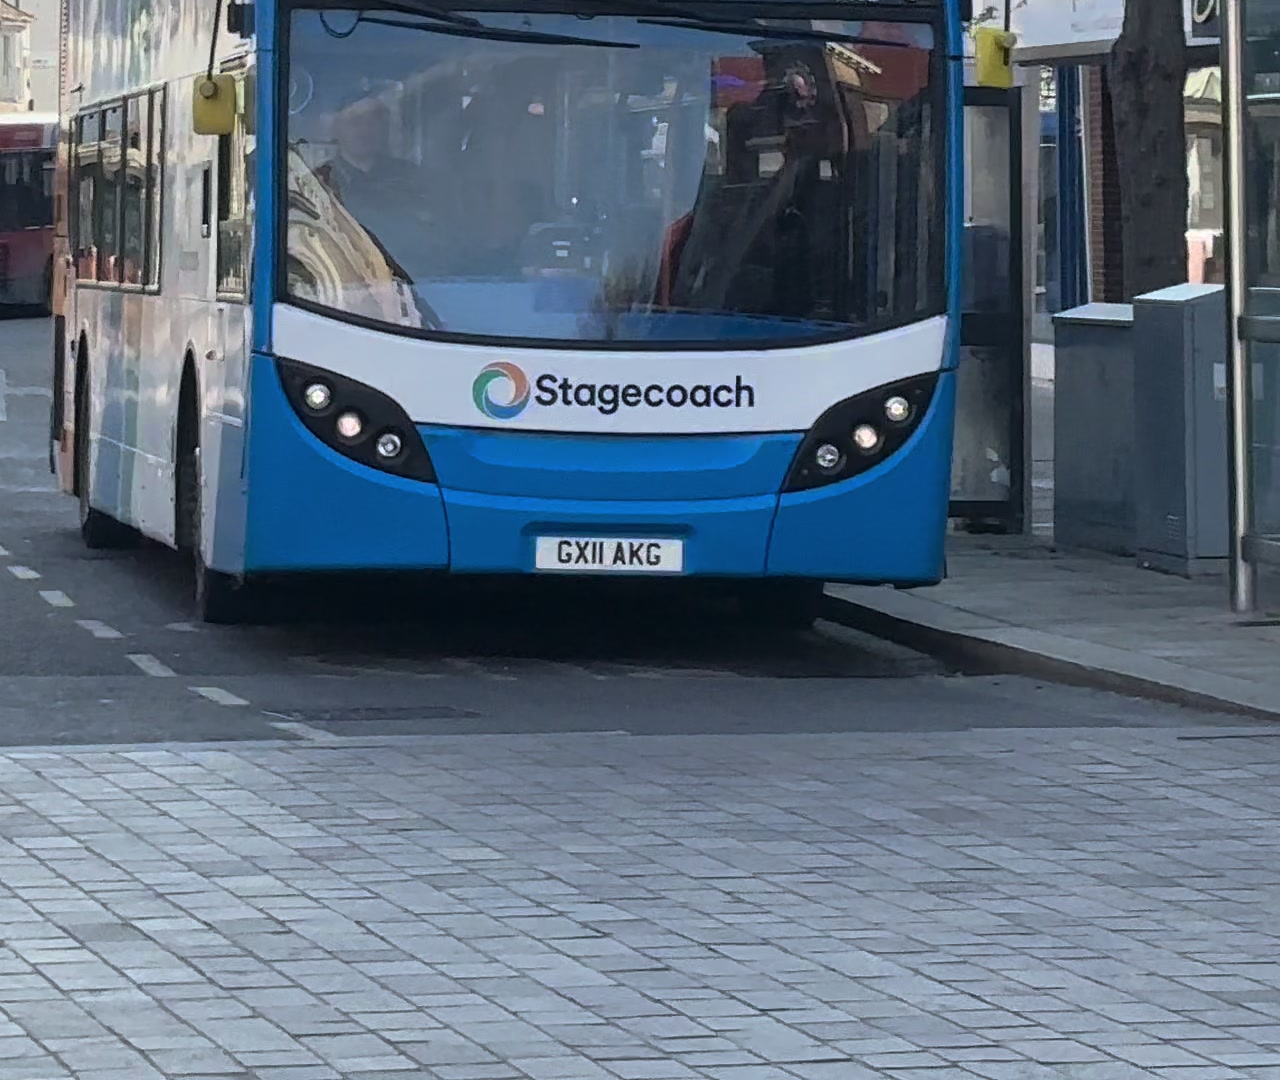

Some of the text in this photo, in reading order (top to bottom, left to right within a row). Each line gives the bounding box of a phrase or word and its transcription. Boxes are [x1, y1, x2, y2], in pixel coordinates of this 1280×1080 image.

[535, 373, 756, 416] Stagecoach
[556, 539, 663, 567] GX11 AKG
